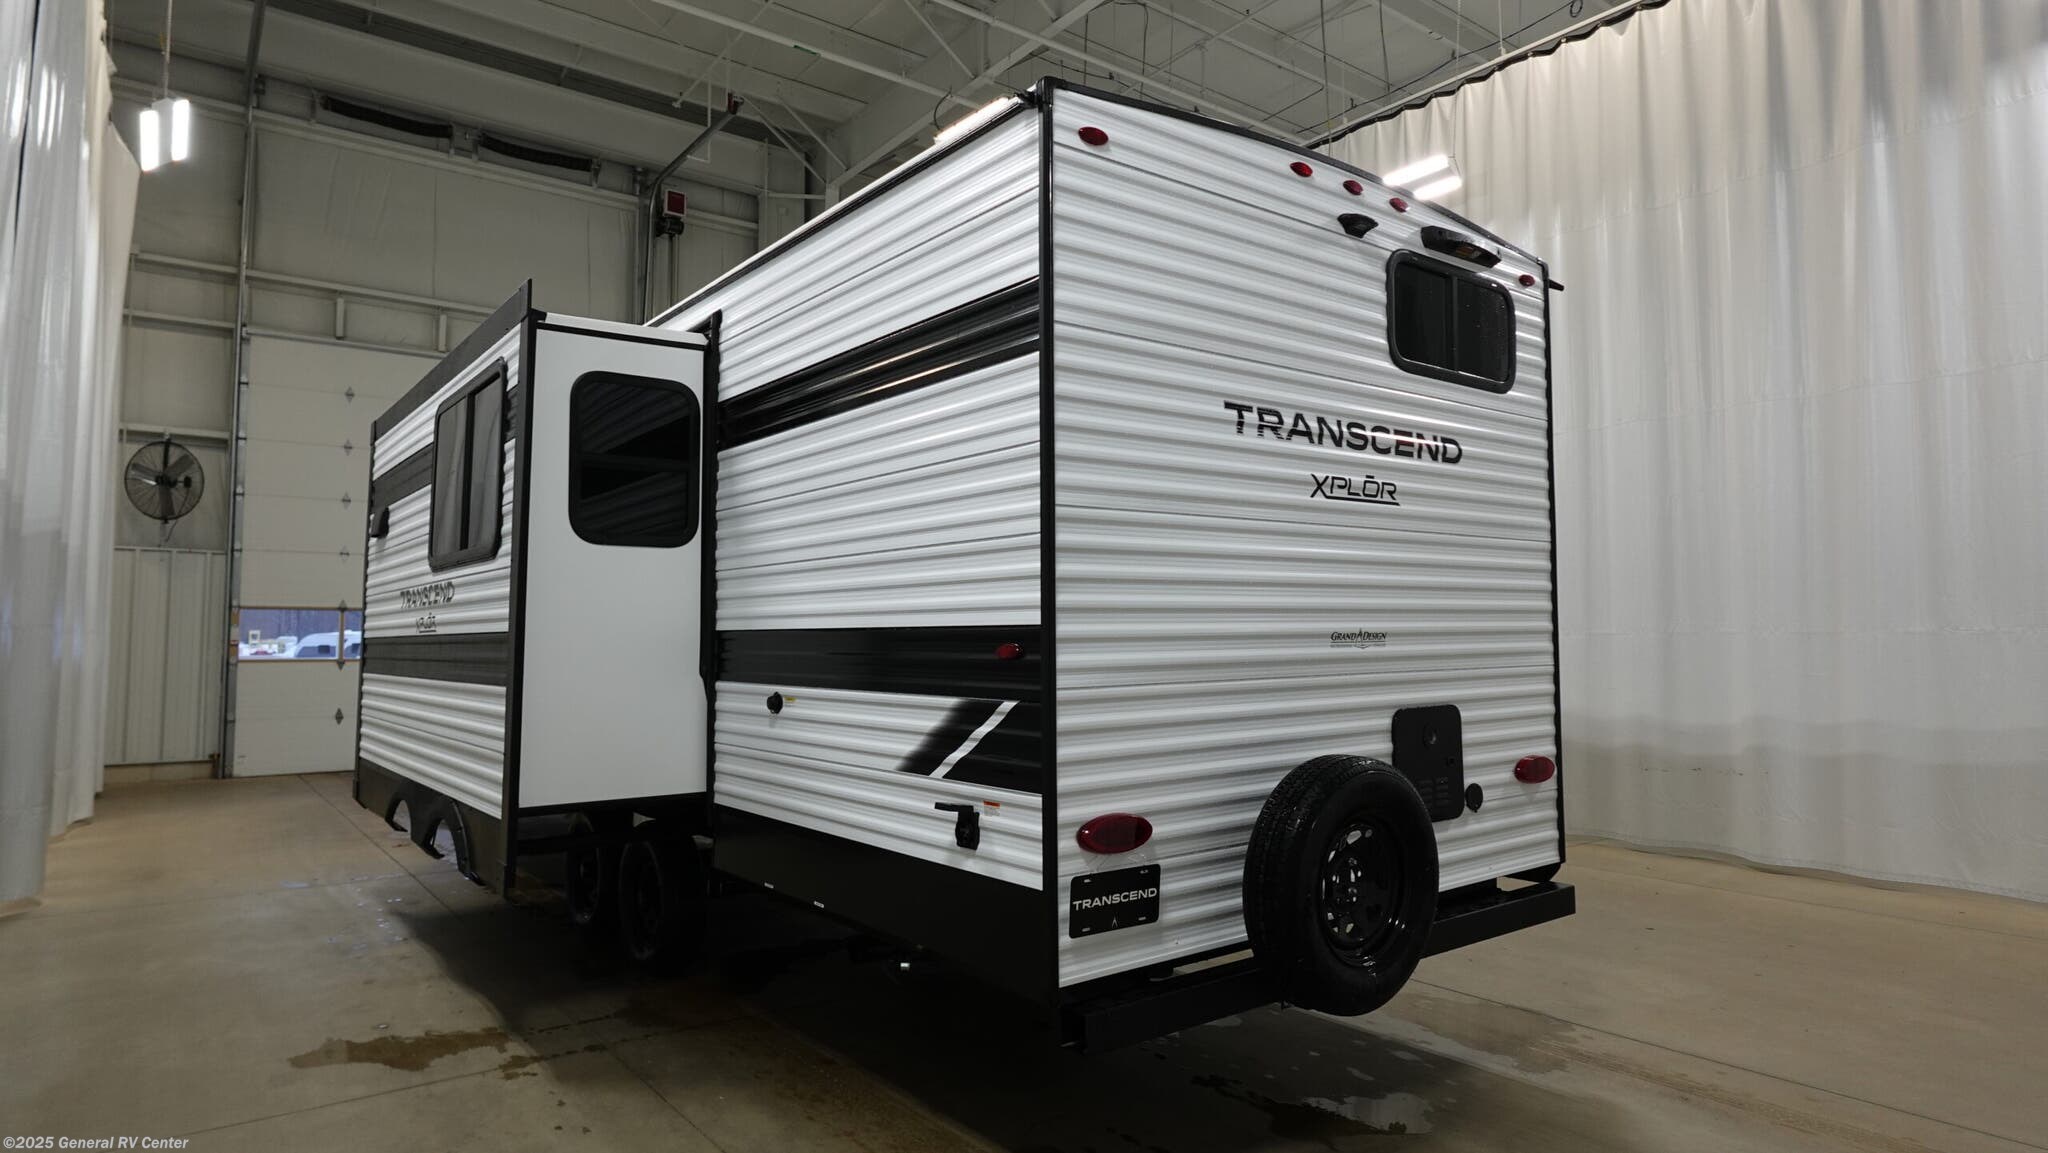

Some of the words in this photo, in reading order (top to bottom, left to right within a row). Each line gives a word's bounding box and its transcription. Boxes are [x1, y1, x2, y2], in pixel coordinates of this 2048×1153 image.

[1224, 400, 1463, 464] TRANSCEND
[400, 581, 455, 609] TRANSCEND
[1072, 887, 1158, 911] TRANSCEND
